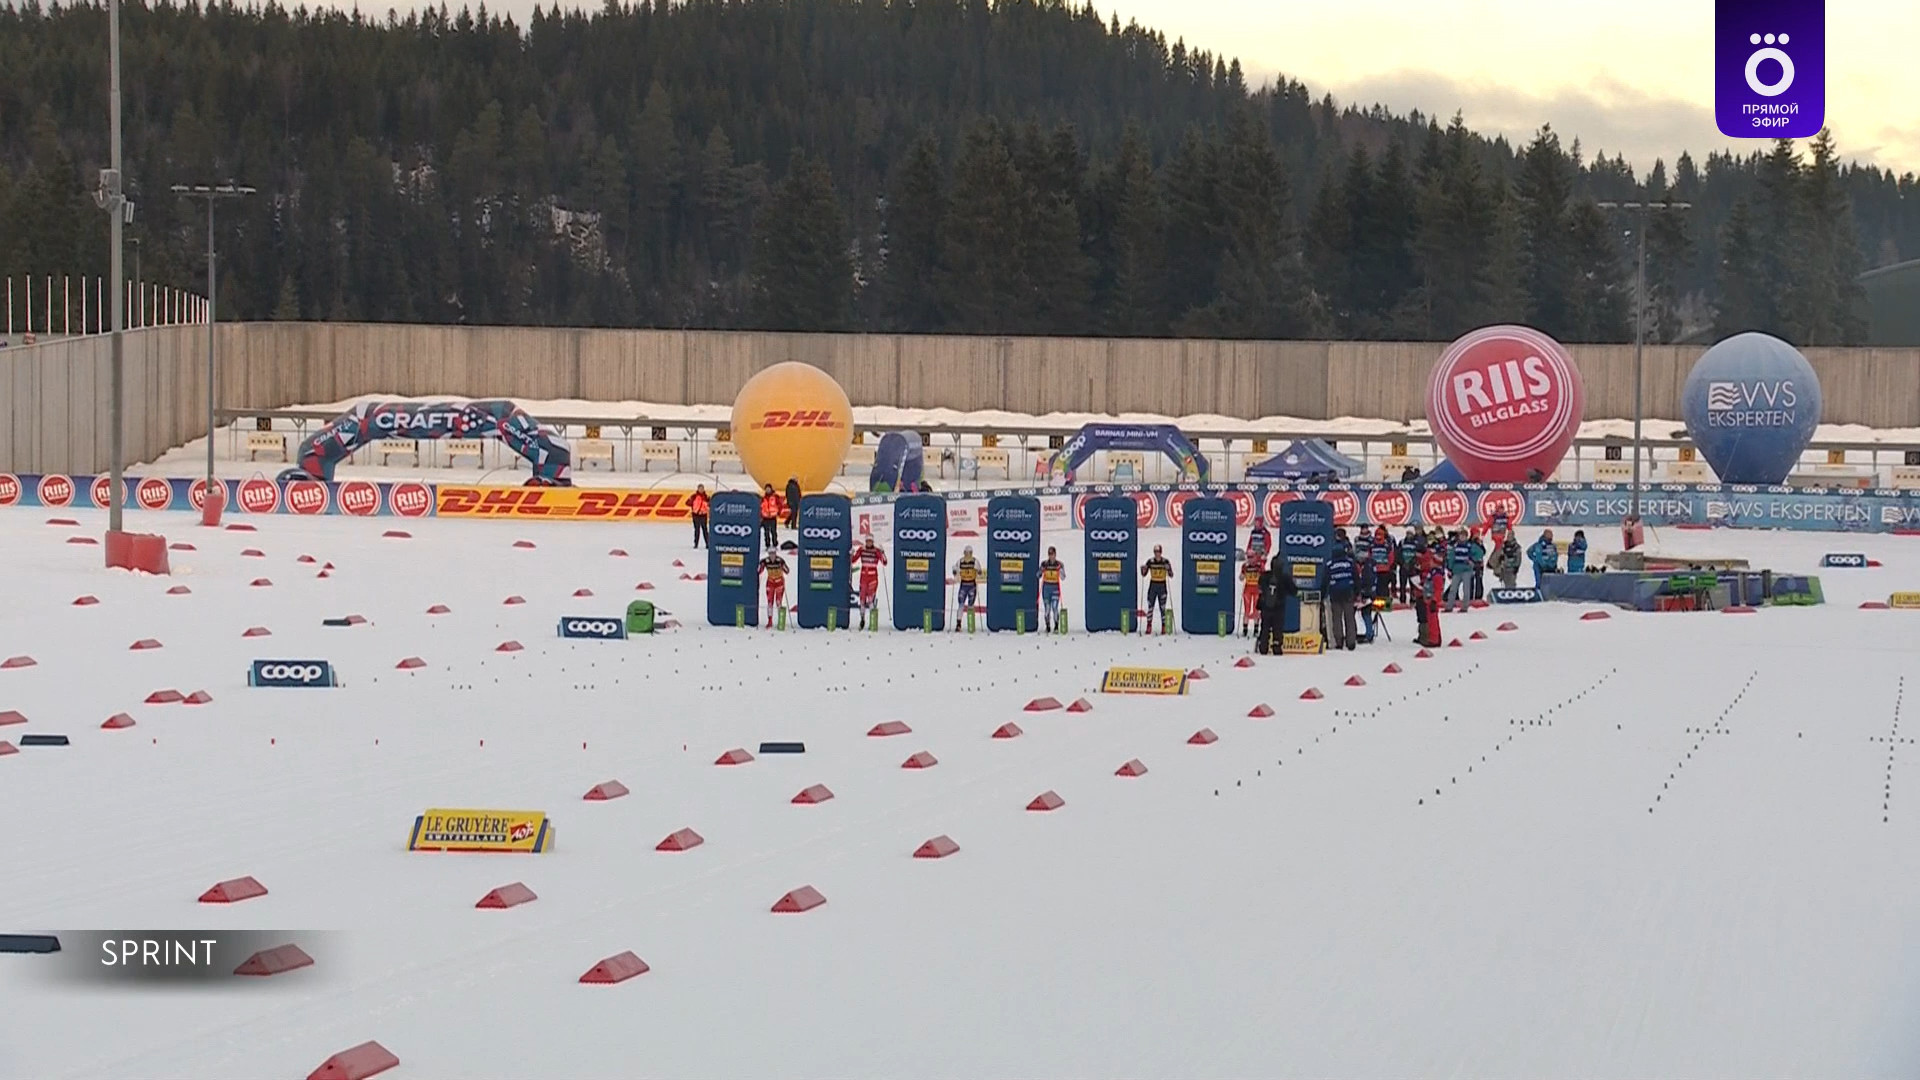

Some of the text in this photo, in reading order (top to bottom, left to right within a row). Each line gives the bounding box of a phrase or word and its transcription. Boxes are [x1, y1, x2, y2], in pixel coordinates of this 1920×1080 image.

[1453, 356, 1551, 415] RIIS
[1740, 381, 1797, 408] VVS
[763, 411, 835, 428] DHL
[1470, 399, 1549, 428] BILGLASS
[1708, 410, 1796, 427] EKSPERTEN
[258, 420, 271, 431] 30
[375, 412, 460, 429] CRAFT
[313, 424, 345, 446] CRAFT
[502, 421, 531, 444] CRAFT
[588, 427, 599, 438] 25
[653, 428, 665, 439] 24
[718, 429, 731, 440] 23
[1059, 434, 1087, 461] coop
[1607, 448, 1620, 459] 10
[1832, 451, 1840, 463] 7
[44, 483, 69, 497] RIIS
[1121, 484, 1142, 492] coop
[1150, 484, 1170, 492] coop
[1178, 484, 1199, 492] coop
[1207, 483, 1228, 492] coop
[1236, 483, 1258, 491] coop
[1268, 483, 1289, 491] coop
[1298, 483, 1320, 492] coop
[1328, 482, 1351, 491] coop
[1360, 482, 1383, 491] coop
[1390, 482, 1414, 491] coop
[1424, 482, 1448, 491] coop
[1457, 482, 1481, 491] coop
[1490, 482, 1514, 491] coop
[1524, 482, 1548, 491] coop
[1558, 482, 1582, 491] coop
[1592, 483, 1616, 492] coop
[1662, 484, 1686, 492] coop
[1696, 484, 1722, 492] coop
[1732, 485, 1757, 494] coop
[1768, 486, 1794, 494] coop
[1802, 486, 1828, 495] coop
[1838, 488, 1864, 497] coop
[142, 486, 167, 500] RIIS
[244, 486, 273, 502] RIIS
[292, 487, 322, 504] RIIS
[344, 488, 374, 505] RIIS
[396, 489, 427, 507] RIIS
[1874, 488, 1900, 498] coop
[439, 488, 552, 514] DHL
[576, 492, 691, 518] DHL
[1333, 497, 1352, 513] IIS
[1374, 496, 1405, 515] RIIS
[1428, 497, 1460, 516] RIIS
[1555, 500, 1589, 516] VVS
[1728, 502, 1871, 521] VVS EKSPERTEN
[714, 524, 752, 537] coop
[804, 528, 841, 540] coop
[899, 530, 937, 542] coop
[994, 530, 1032, 542] coop
[1090, 530, 1129, 542] coop
[1188, 532, 1228, 544] coop
[1286, 534, 1325, 547] coop
[1829, 556, 1861, 566] coop
[1498, 590, 1535, 600] coop
[568, 620, 618, 636] coop
[261, 664, 322, 682] coop
[426, 814, 509, 833] LE GRUYÈRE
[427, 834, 504, 842] SWITZERLAND
